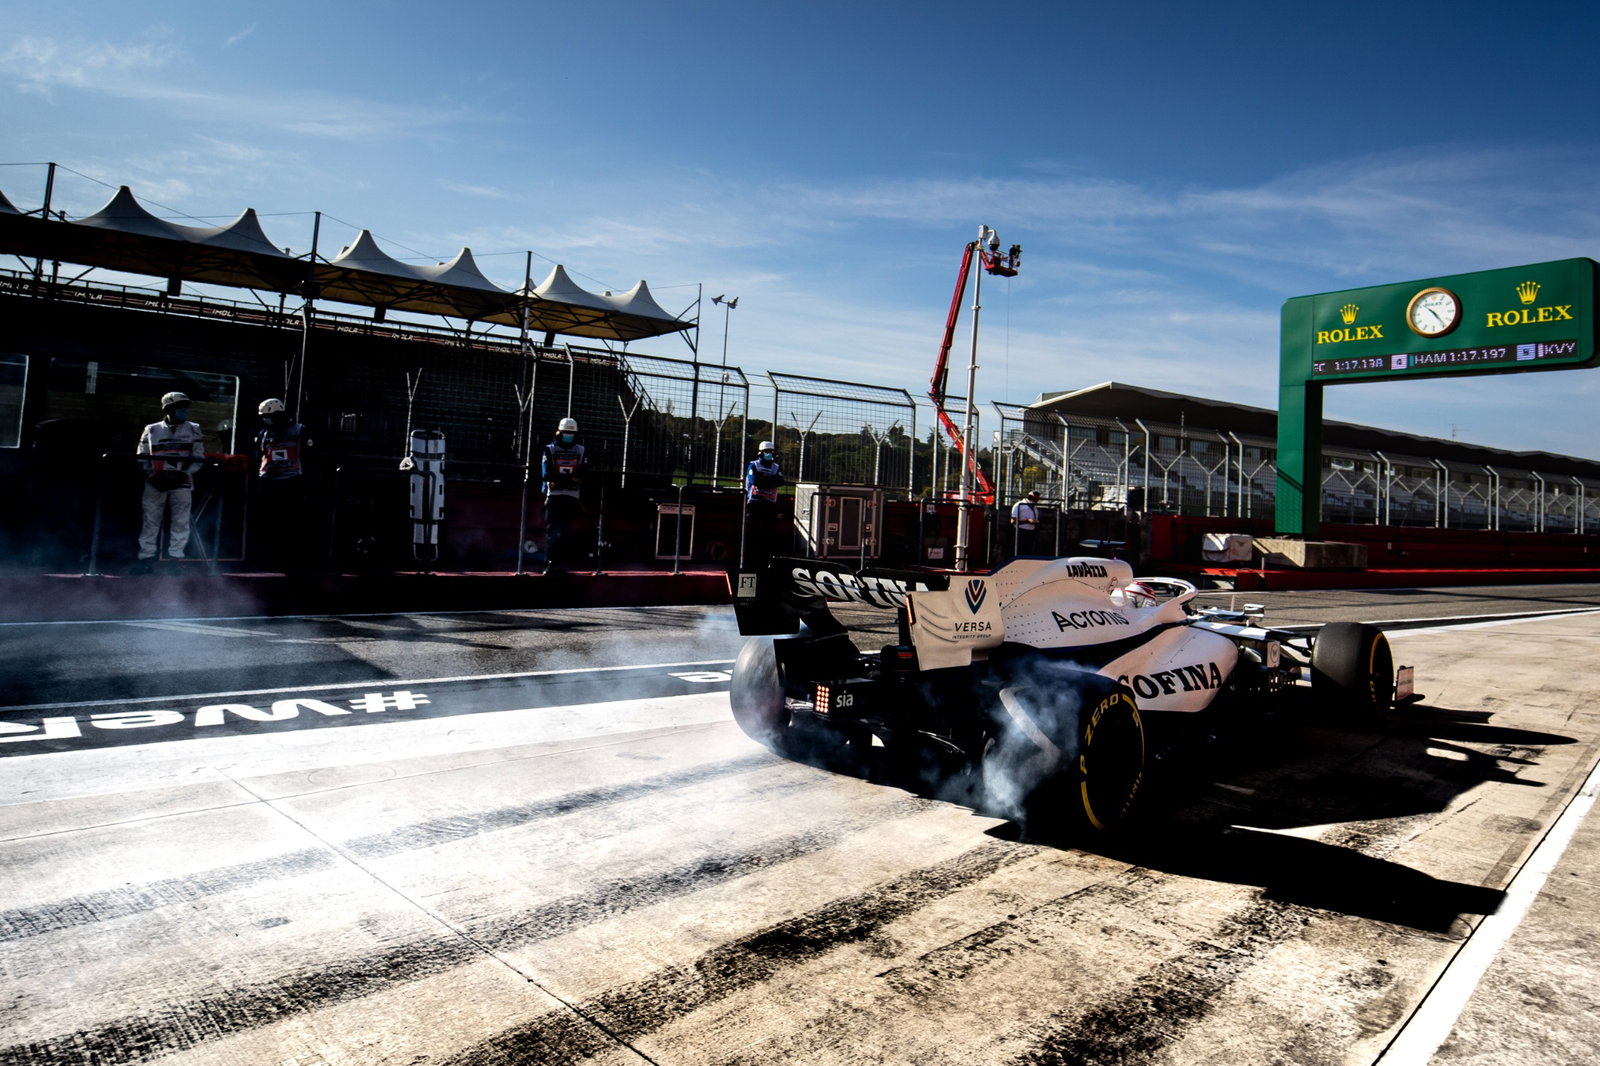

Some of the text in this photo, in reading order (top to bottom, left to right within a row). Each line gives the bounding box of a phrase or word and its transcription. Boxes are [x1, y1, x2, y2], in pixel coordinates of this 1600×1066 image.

[1486, 304, 1574, 328] ROLEX
[1317, 325, 1385, 345] ROLEX
[1414, 353, 1447, 365] HAM
[1449, 348, 1506, 362] 1:17.197
[1544, 342, 1577, 354] KVY
[1066, 562, 1108, 578] LAVAZZA
[740, 576, 755, 588] FT
[791, 567, 929, 609] SOFIN
[955, 621, 992, 632] VERSA
[1052, 608, 1130, 632] Acronis
[836, 690, 854, 708] sia
